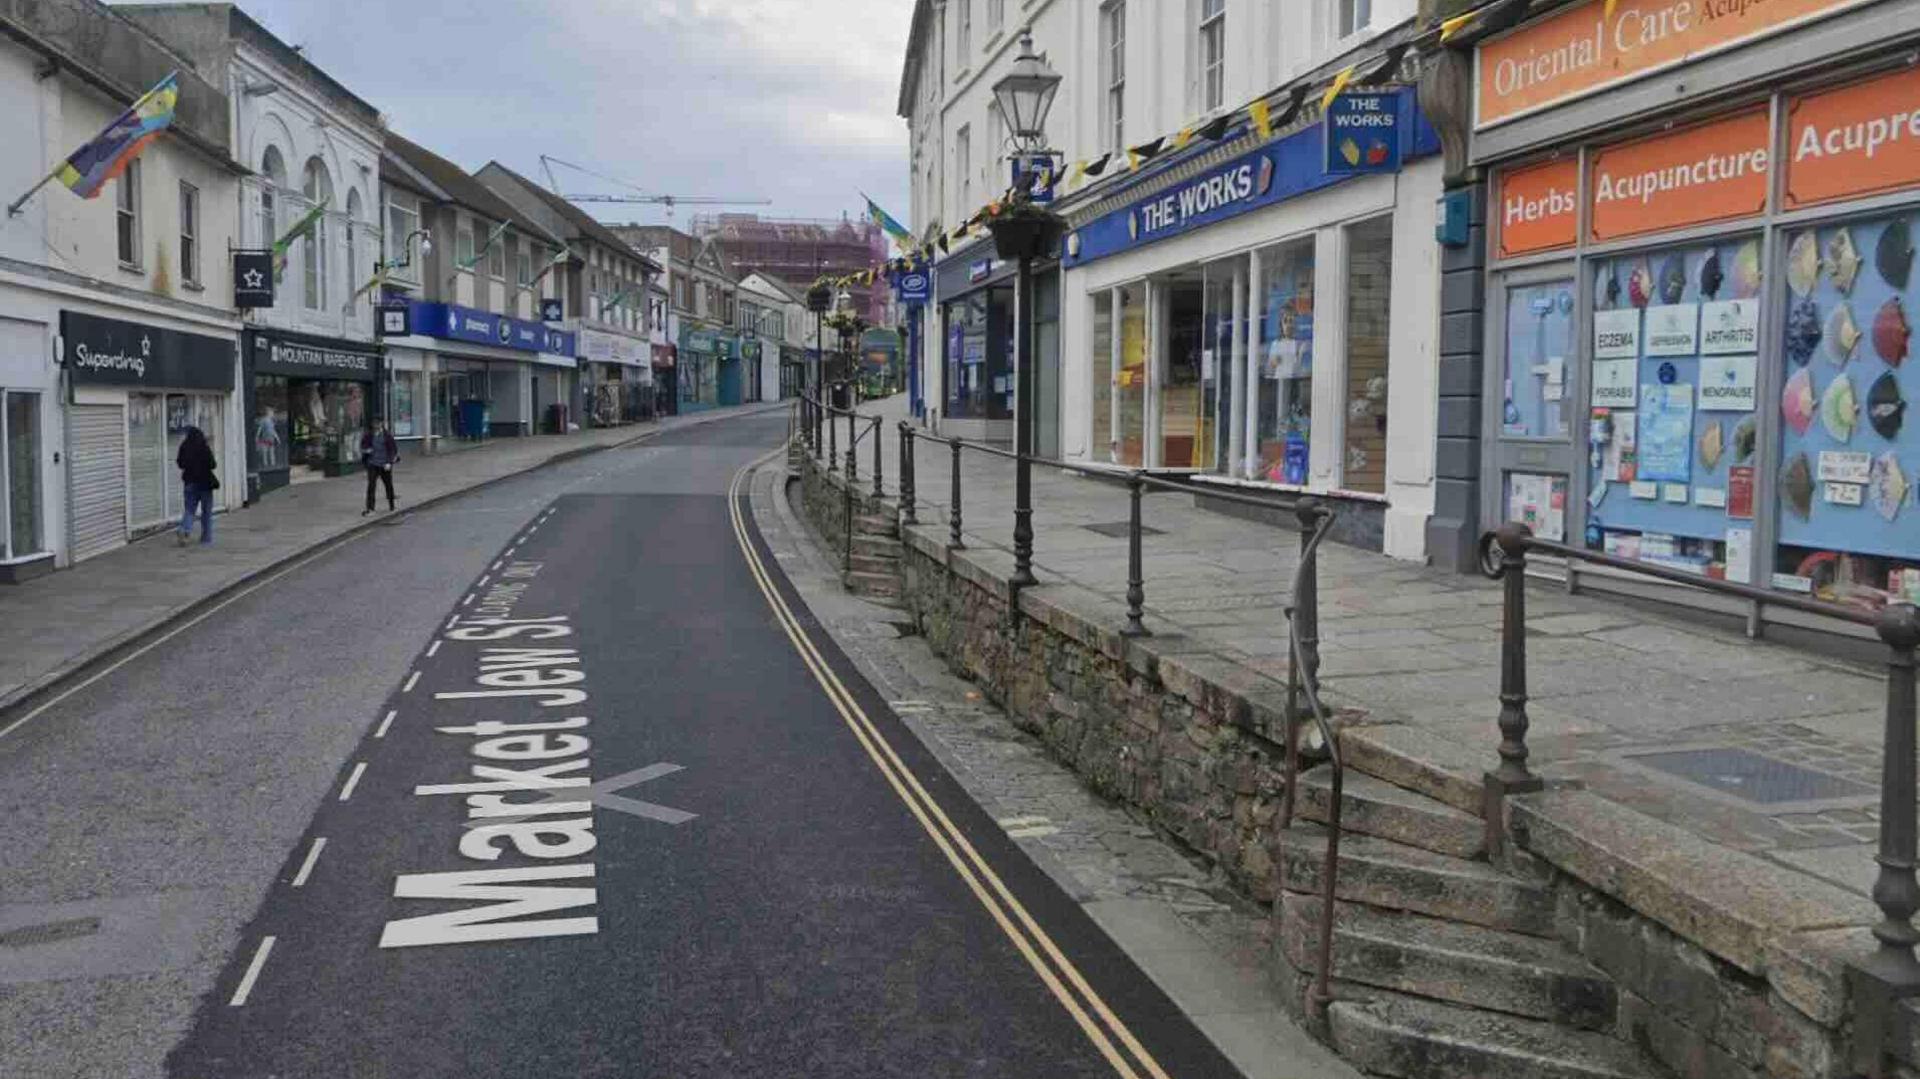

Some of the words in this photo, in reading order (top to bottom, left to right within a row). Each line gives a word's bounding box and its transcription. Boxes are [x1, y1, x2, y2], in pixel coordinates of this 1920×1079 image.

[1495, 22, 1602, 97] Oriental
[1615, 1, 1691, 54] Care
[1347, 97, 1380, 112] THE
[1336, 113, 1393, 128] WORKS
[1595, 146, 1768, 205] Acupuncture
[1142, 198, 1175, 233] THE
[1179, 165, 1253, 214] WORKS
[1505, 187, 1575, 226] Herbs
[1599, 331, 1634, 348] ECZEMA
[1704, 328, 1754, 345] ARTHRITIS
[76, 343, 145, 377] Superdrug
[279, 347, 322, 365] MOUNTAIN
[323, 351, 369, 370] WAREHOUSE
[1702, 386, 1754, 399] MENOPAUSE
